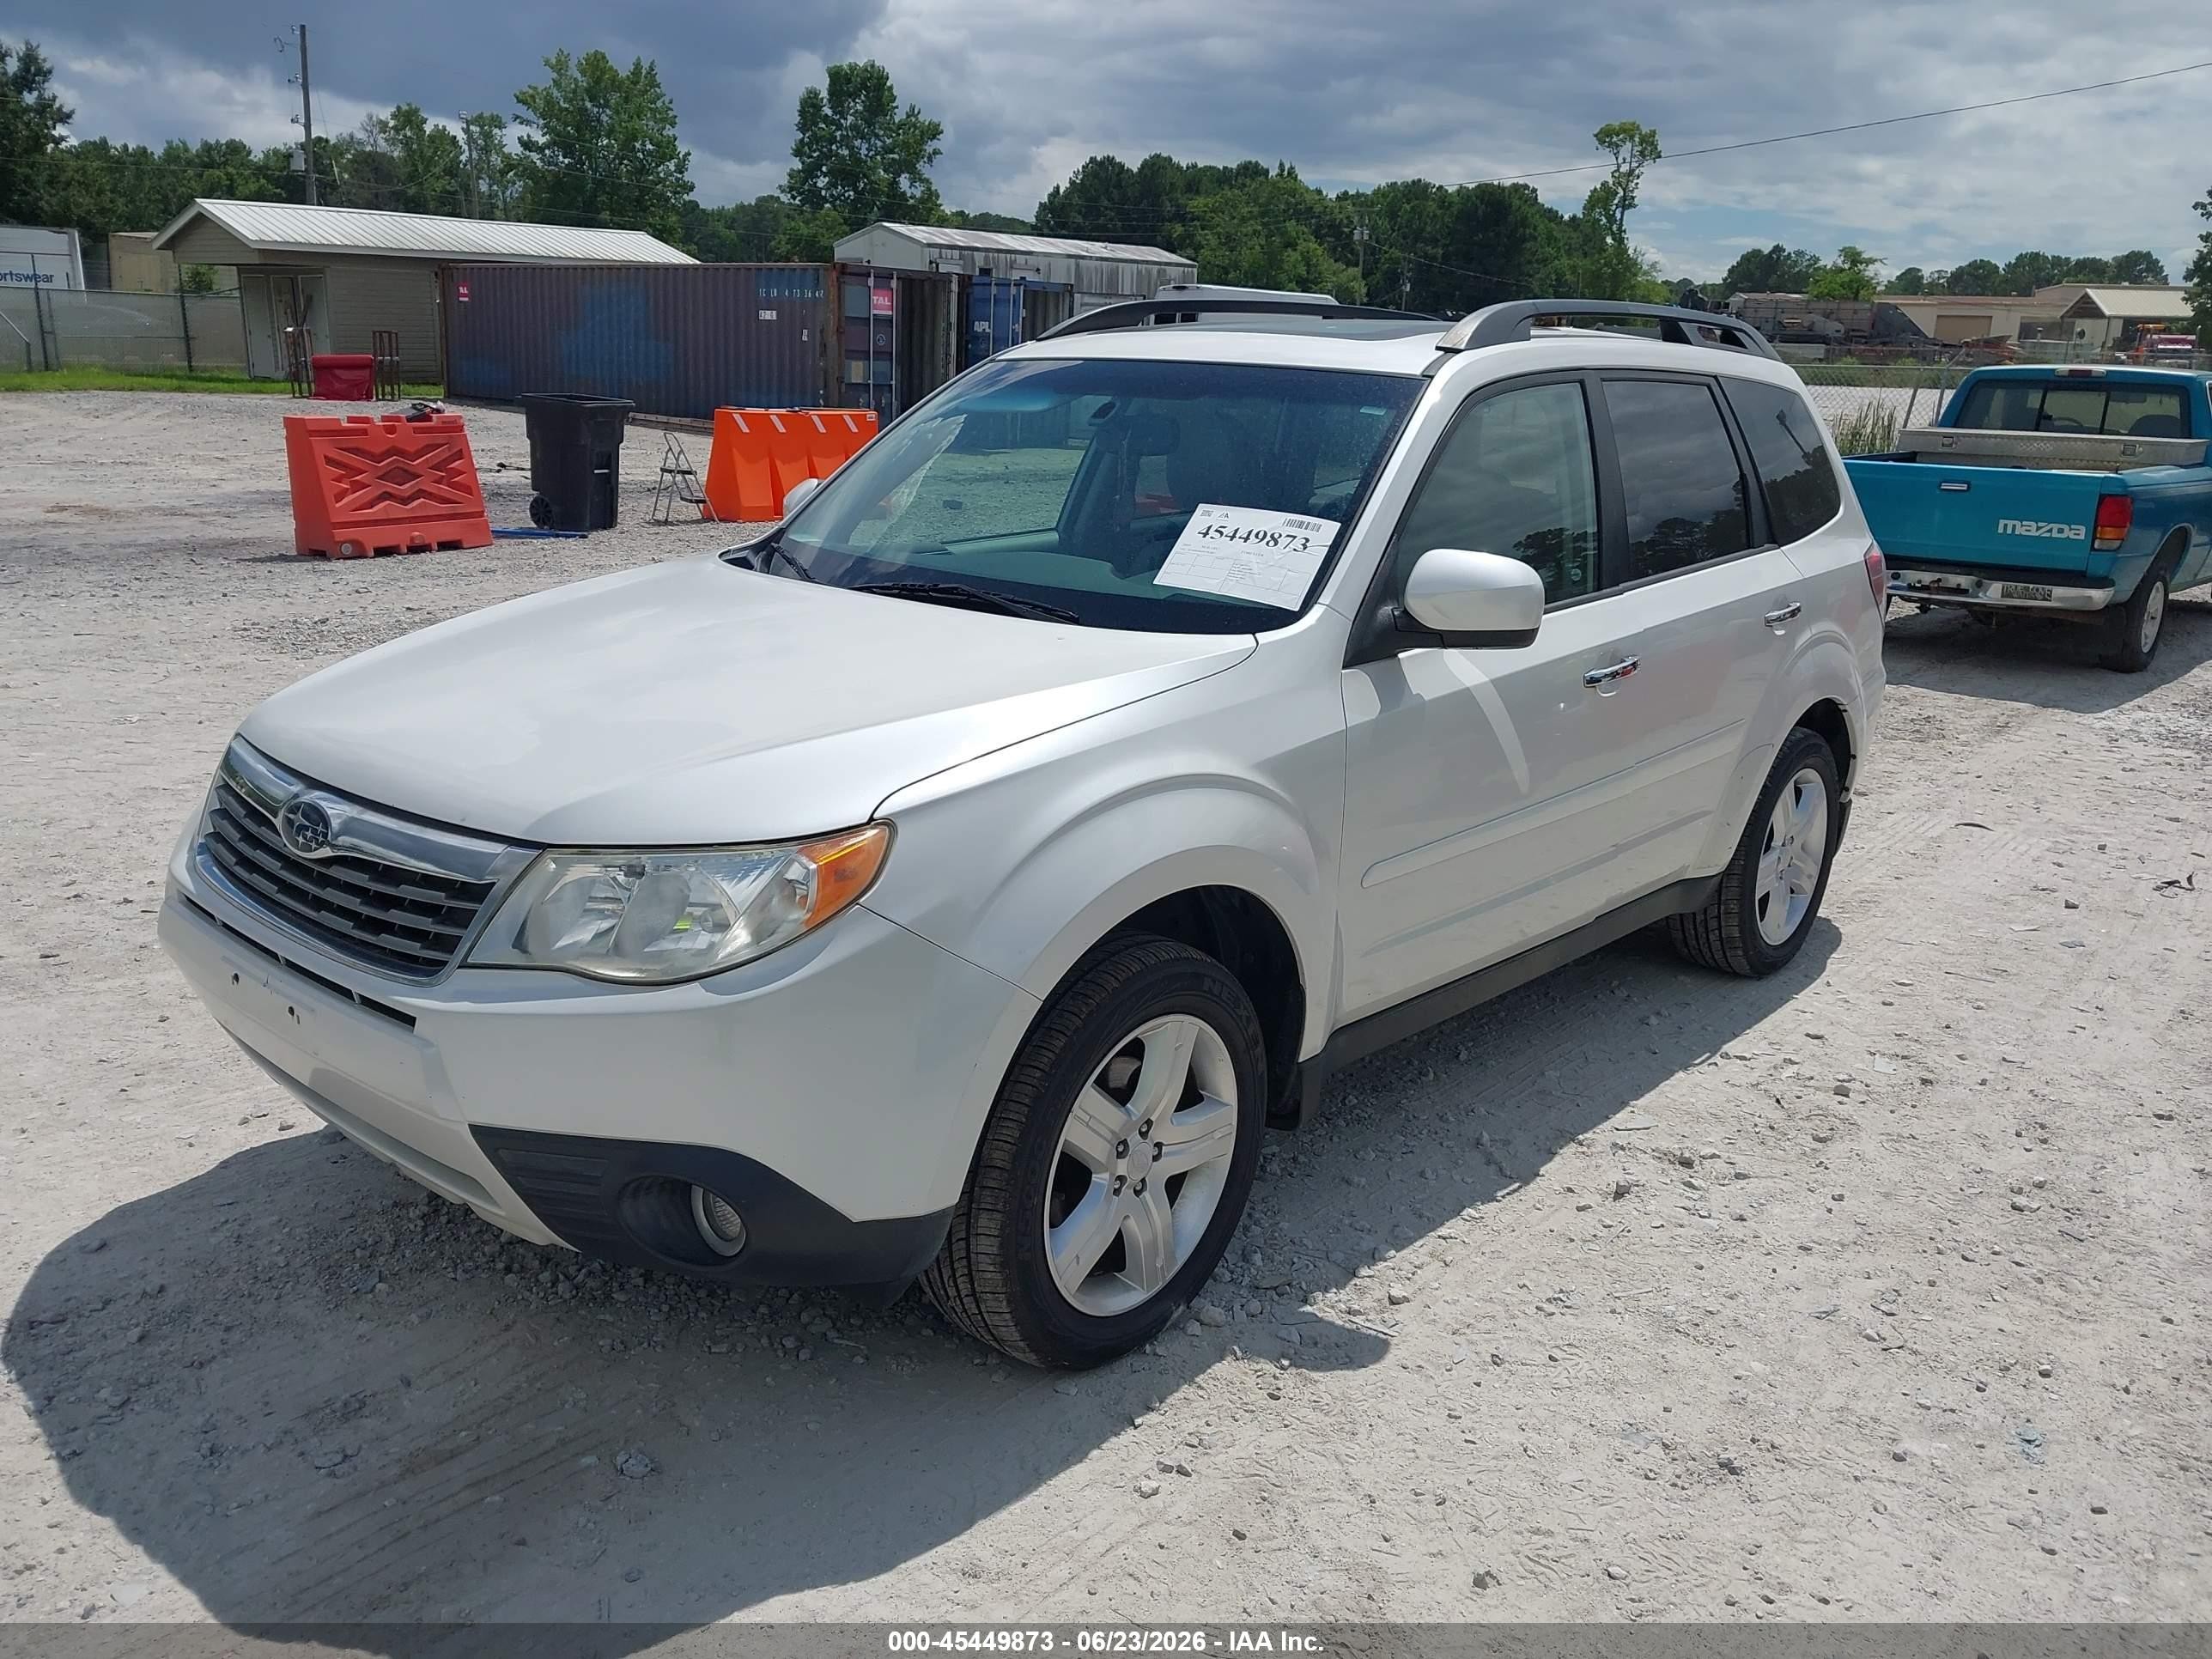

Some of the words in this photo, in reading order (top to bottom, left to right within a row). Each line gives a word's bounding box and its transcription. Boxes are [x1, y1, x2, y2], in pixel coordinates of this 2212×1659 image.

[872, 295, 891, 305] TAL
[974, 320, 991, 332] APL
[1197, 523, 1310, 552] 45449873
